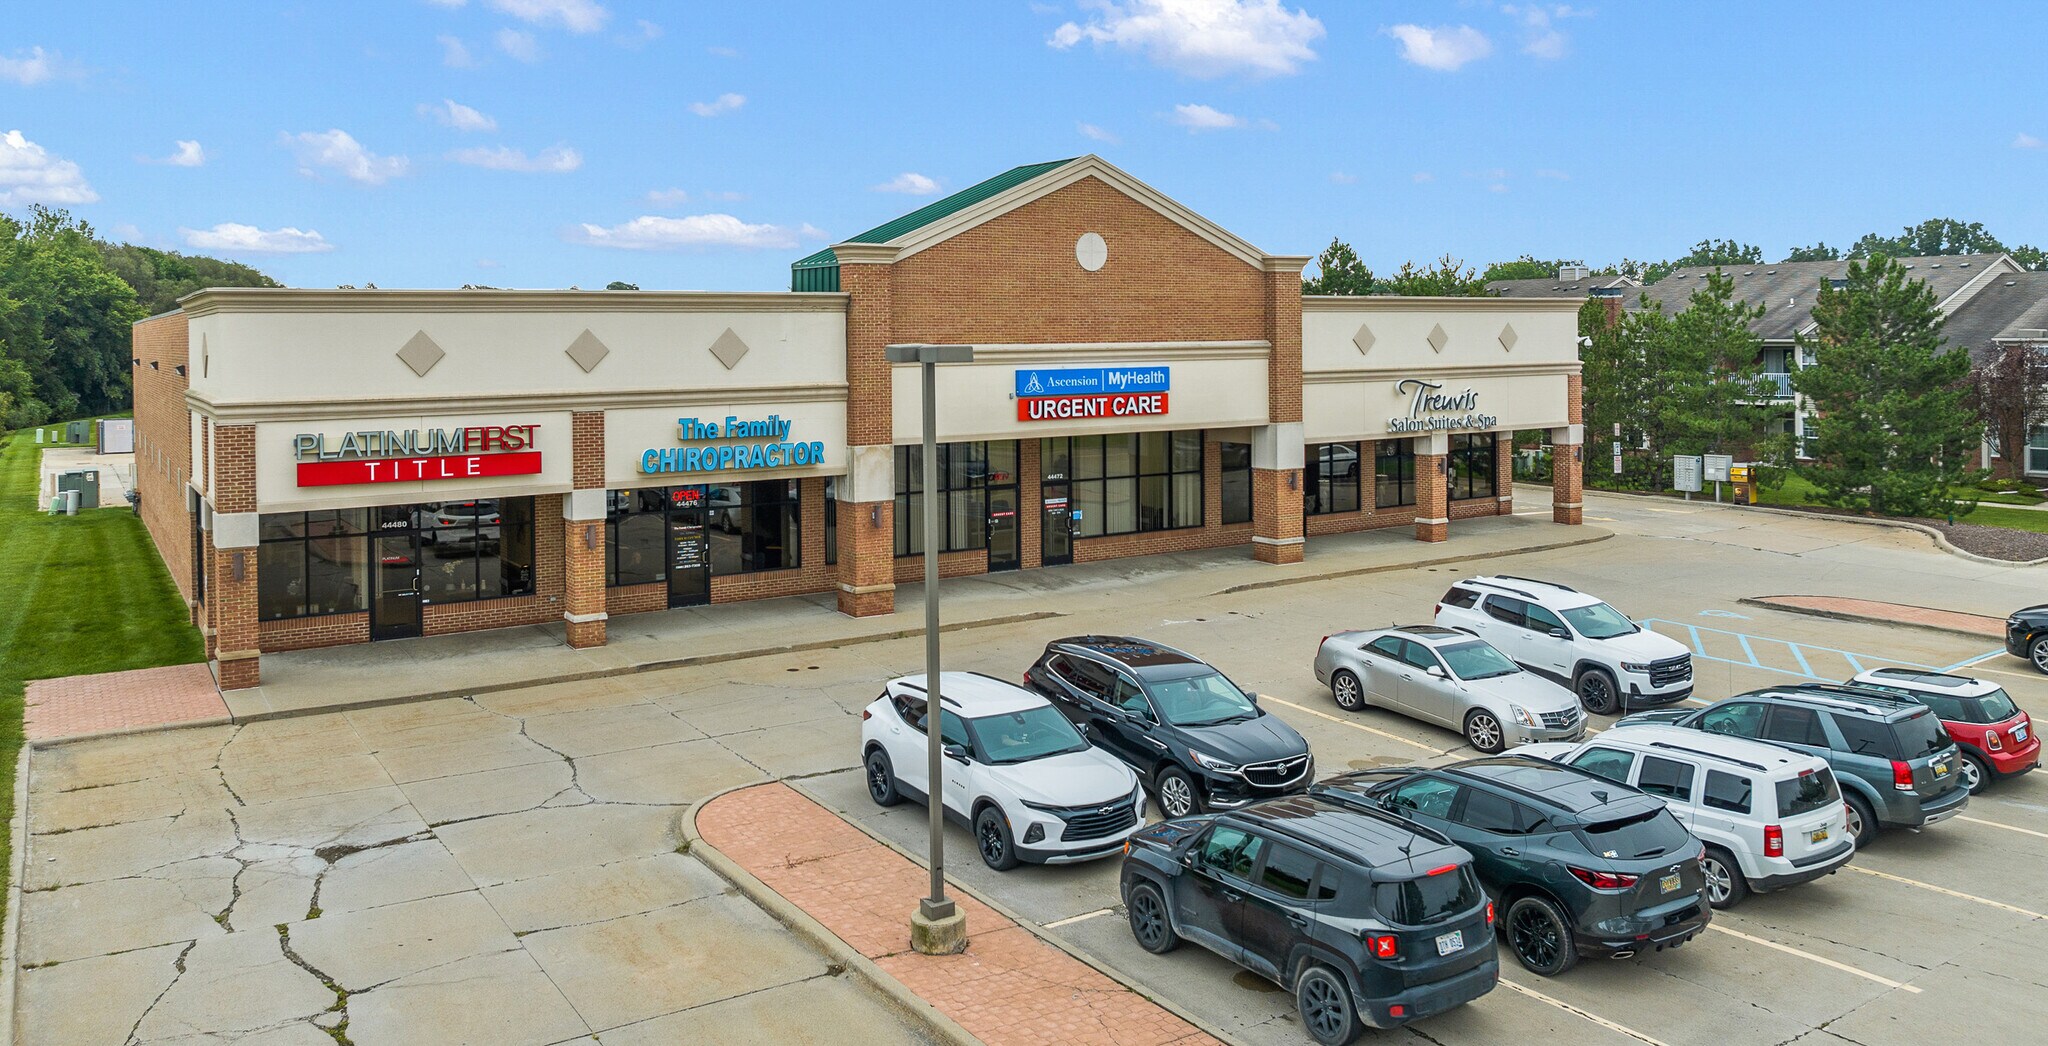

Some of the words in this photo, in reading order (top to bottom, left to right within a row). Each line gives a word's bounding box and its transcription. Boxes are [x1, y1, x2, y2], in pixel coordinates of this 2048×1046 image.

[1047, 375, 1098, 387] Ascension
[1108, 370, 1165, 389] MyHealth
[1029, 398, 1107, 419] URGENT
[1112, 395, 1162, 416] CARE
[1397, 379, 1479, 419] Treuvis
[679, 417, 718, 440] The
[725, 415, 791, 441] Family
[1390, 417, 1424, 432] Salon
[1427, 415, 1462, 430] Suites
[1465, 414, 1473, 427] &
[1477, 413, 1497, 429] Spa
[296, 424, 541, 460] PLATINUMFIRST
[365, 457, 480, 481] TITLE
[641, 441, 825, 474] CHIROPRACTOR
[672, 489, 699, 501] OPEN
[381, 520, 408, 529] 44480
